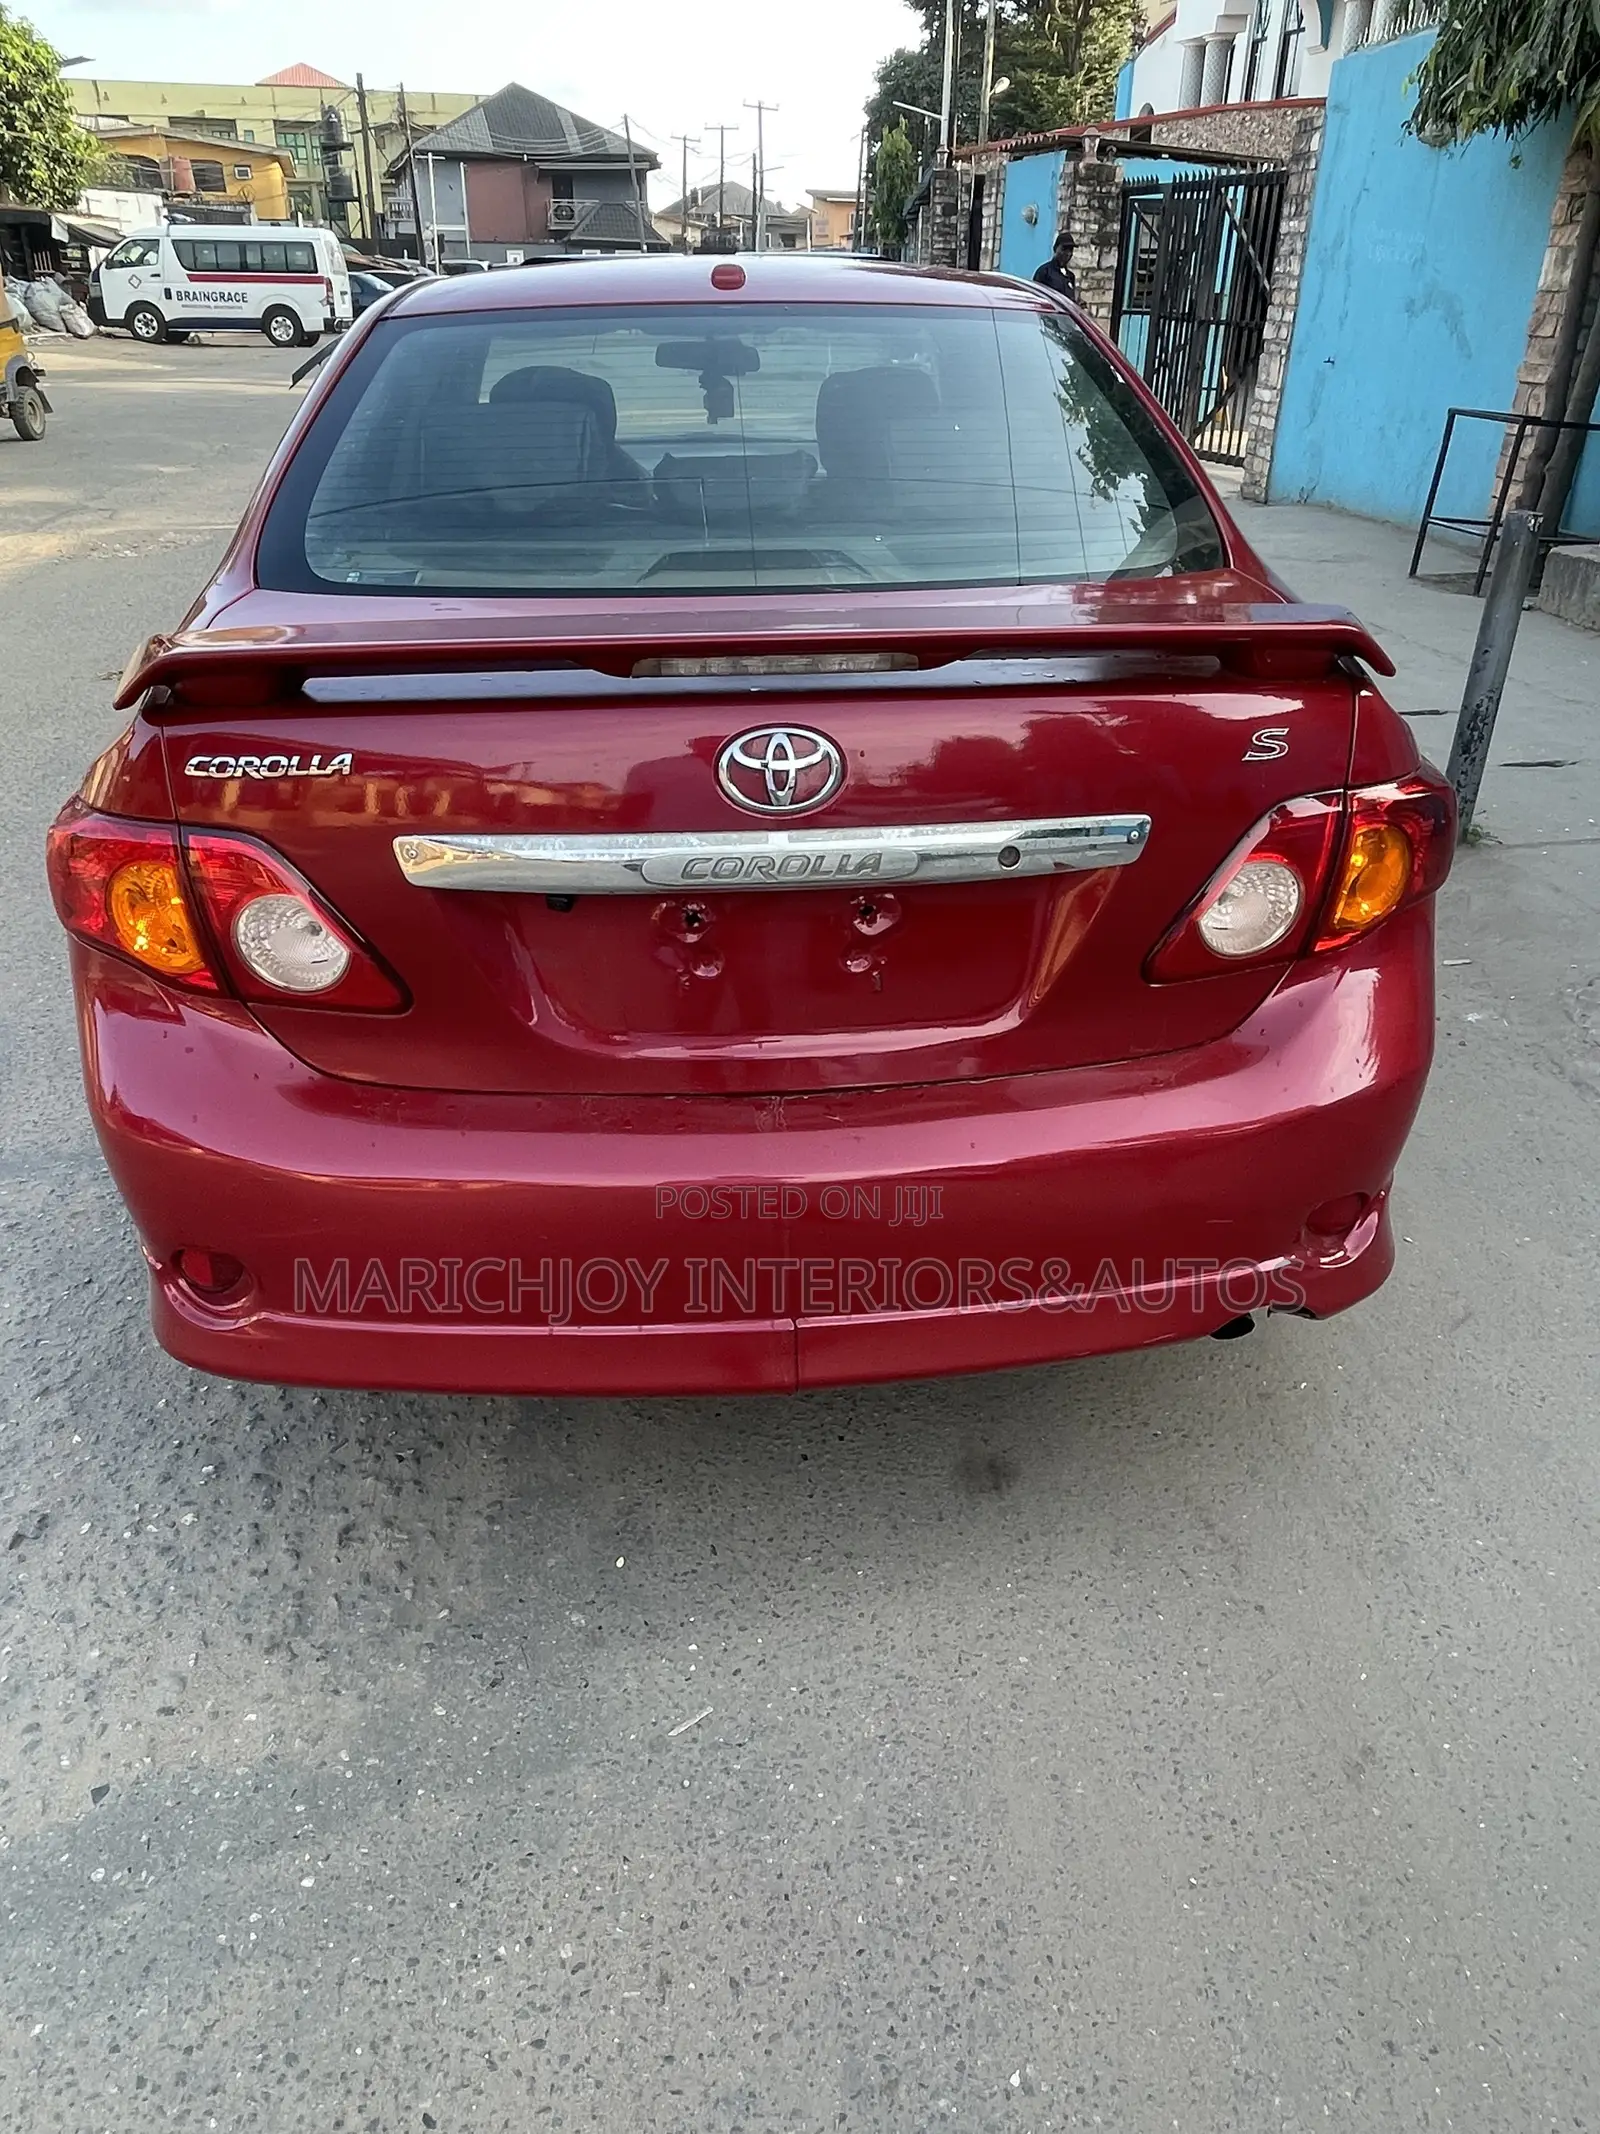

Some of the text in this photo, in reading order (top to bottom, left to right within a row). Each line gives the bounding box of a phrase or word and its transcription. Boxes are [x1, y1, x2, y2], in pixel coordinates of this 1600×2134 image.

[175, 290, 249, 303] BRAINGRACE
[1241, 727, 1290, 761] S
[184, 753, 353, 780] COROLLA
[680, 852, 884, 882] COROLLA
